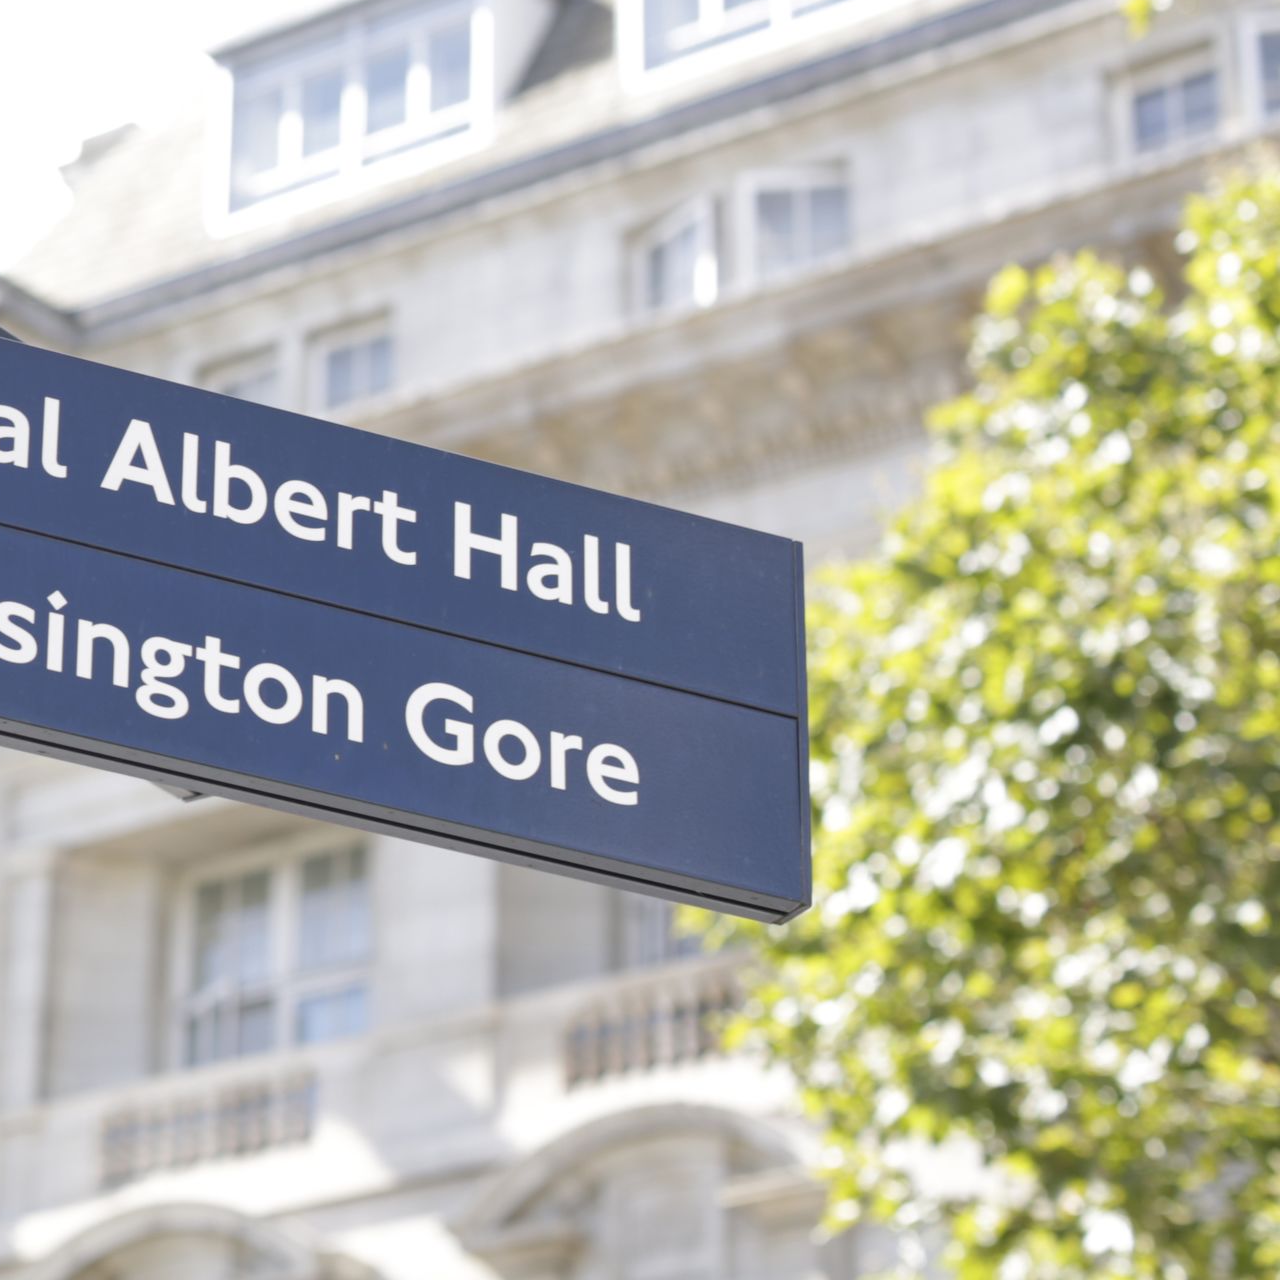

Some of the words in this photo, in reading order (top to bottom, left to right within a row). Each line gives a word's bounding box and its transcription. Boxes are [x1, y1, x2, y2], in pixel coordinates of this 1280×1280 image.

[100, 418, 417, 566] Albert
[453, 501, 641, 623] Hall
[404, 682, 640, 806] Gore
